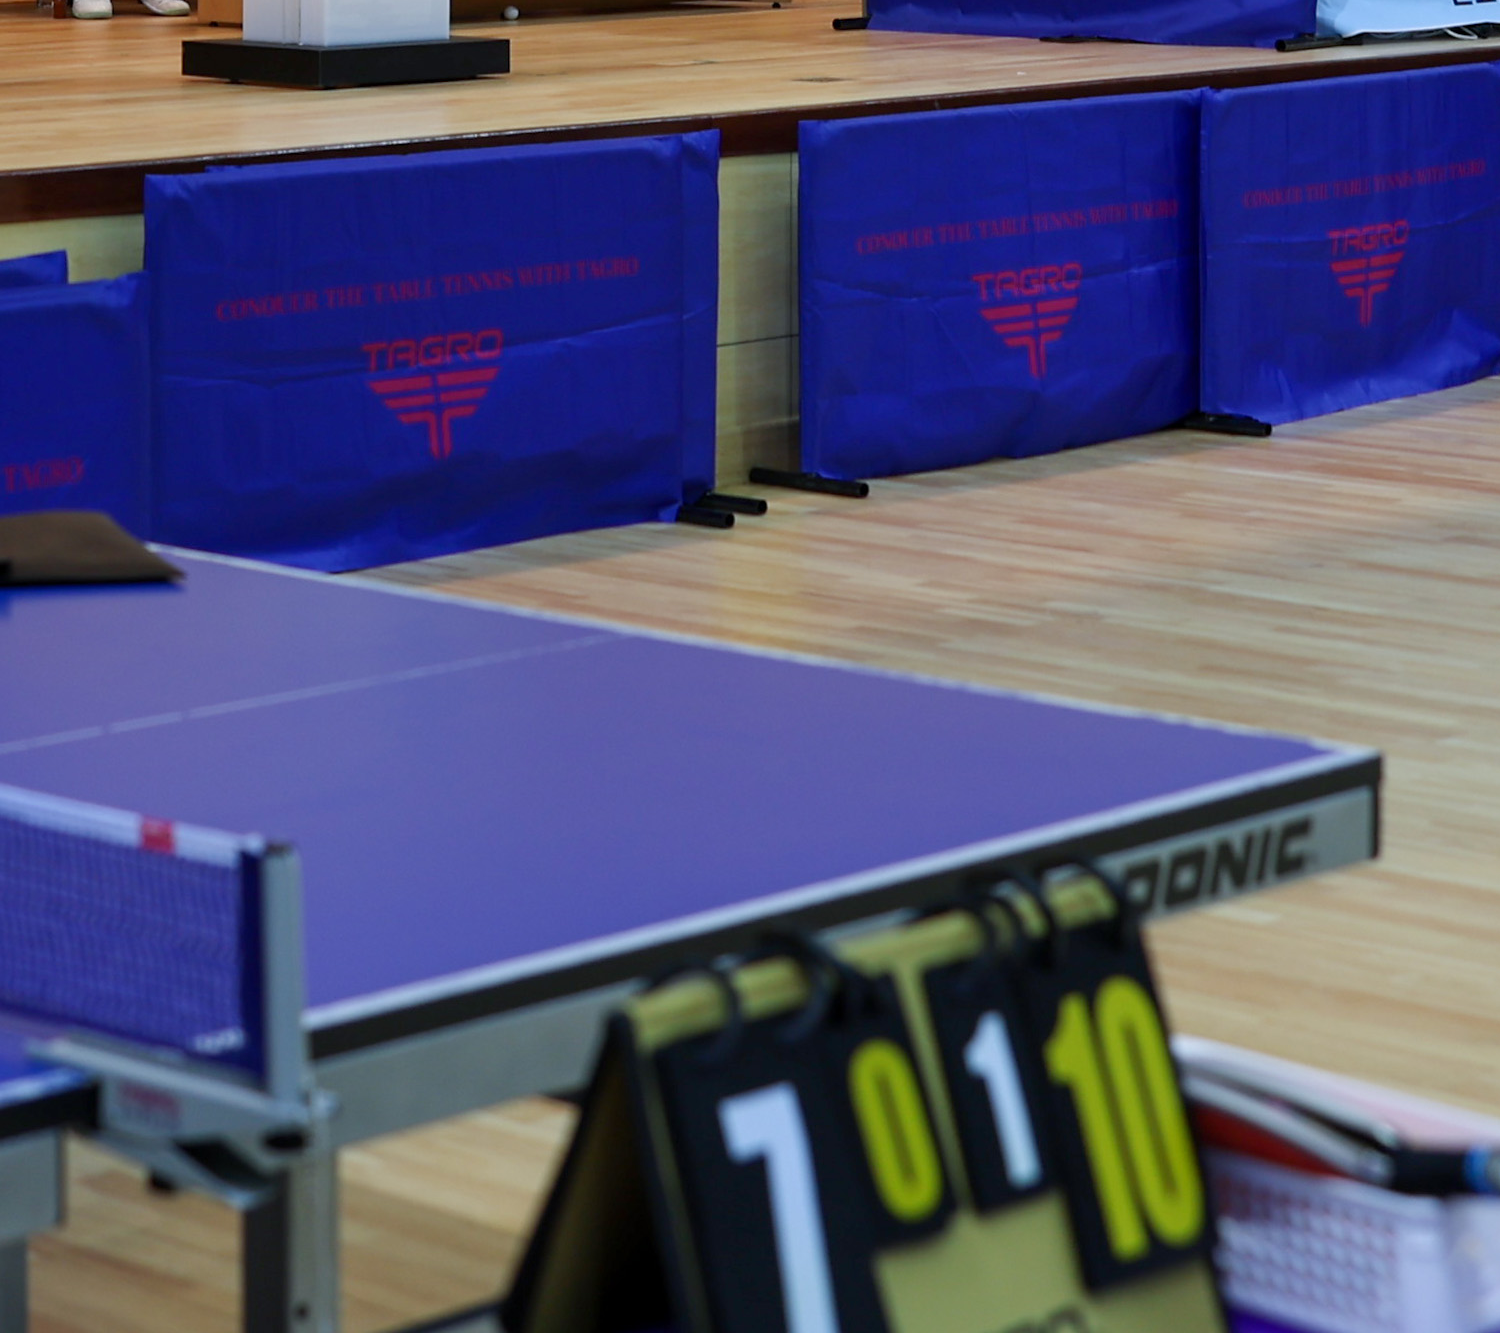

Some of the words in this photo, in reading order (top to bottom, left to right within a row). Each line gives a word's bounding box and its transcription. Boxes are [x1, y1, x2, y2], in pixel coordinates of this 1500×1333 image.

[1325, 218, 1411, 256] TAGRO
[971, 261, 1083, 302] TAGRO
[361, 326, 505, 374] TAGRO
[3, 454, 85, 492] TAGRO
[1043, 975, 1205, 1262] 10
